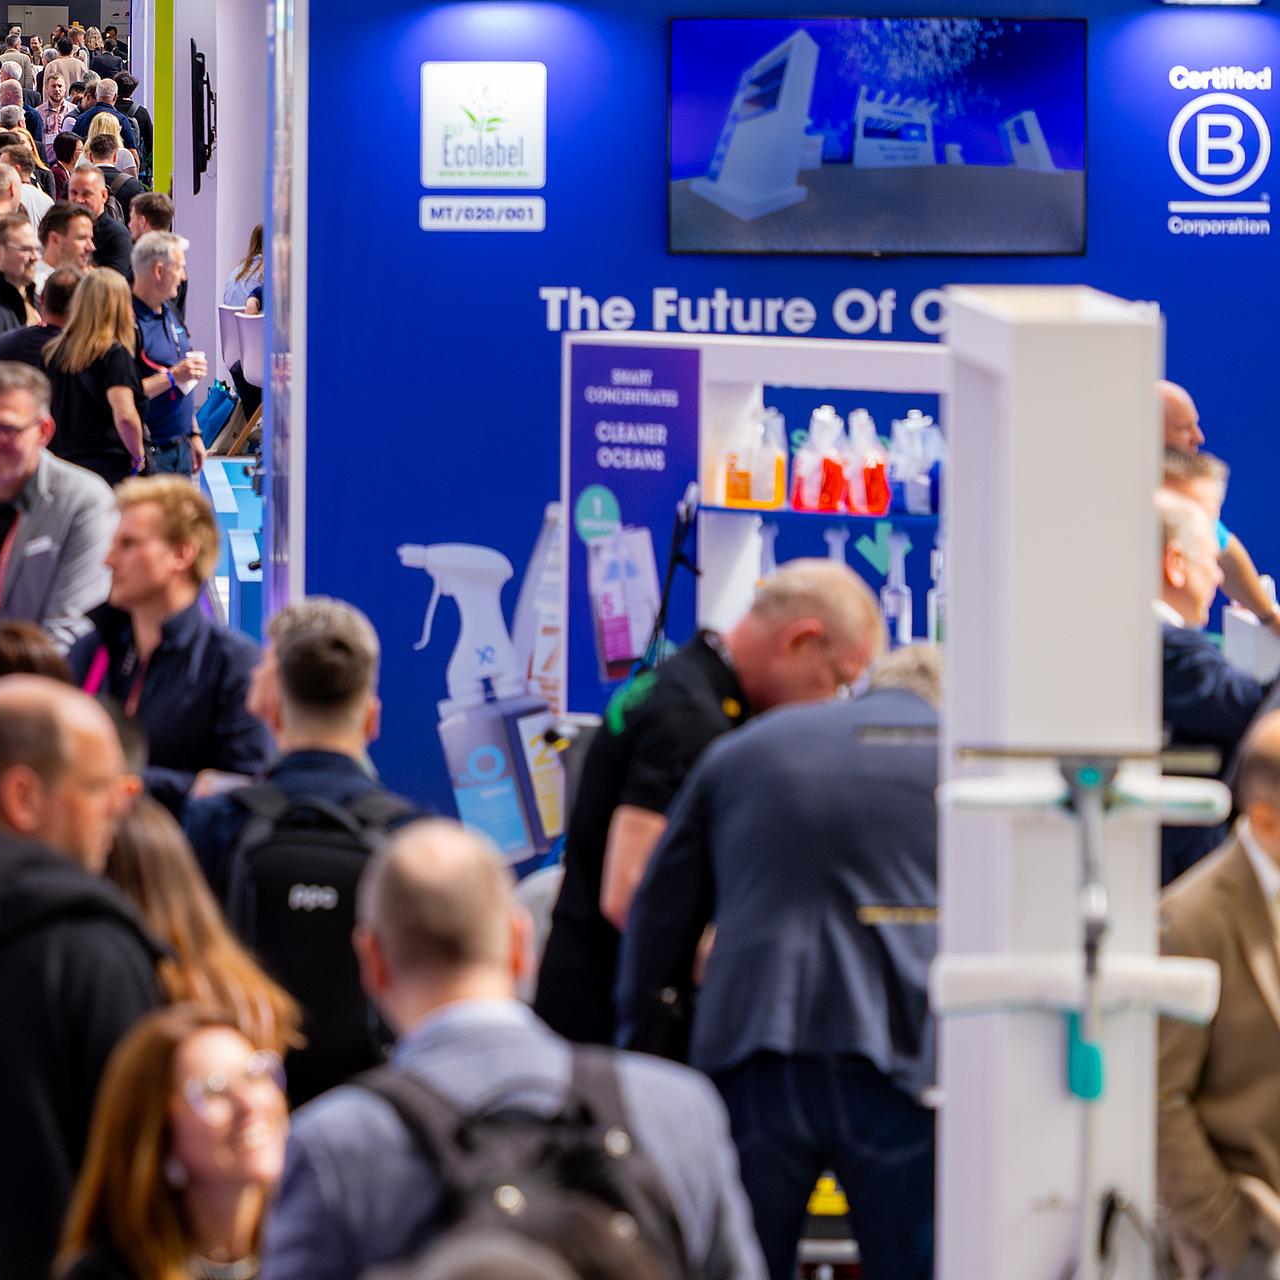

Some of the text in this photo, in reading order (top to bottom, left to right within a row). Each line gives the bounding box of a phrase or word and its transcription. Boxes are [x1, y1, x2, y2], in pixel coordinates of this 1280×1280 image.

[1169, 65, 1272, 90] Certified
[443, 135, 525, 168] Ecolabel
[1196, 113, 1246, 176] B
[1167, 215, 1271, 238] Corporation
[539, 288, 636, 332] The
[652, 288, 818, 333] Future
[832, 288, 897, 334] Of
[585, 386, 680, 408] CONCENTRATES
[595, 421, 668, 446] CLEANER
[596, 447, 667, 471] OCEANS
